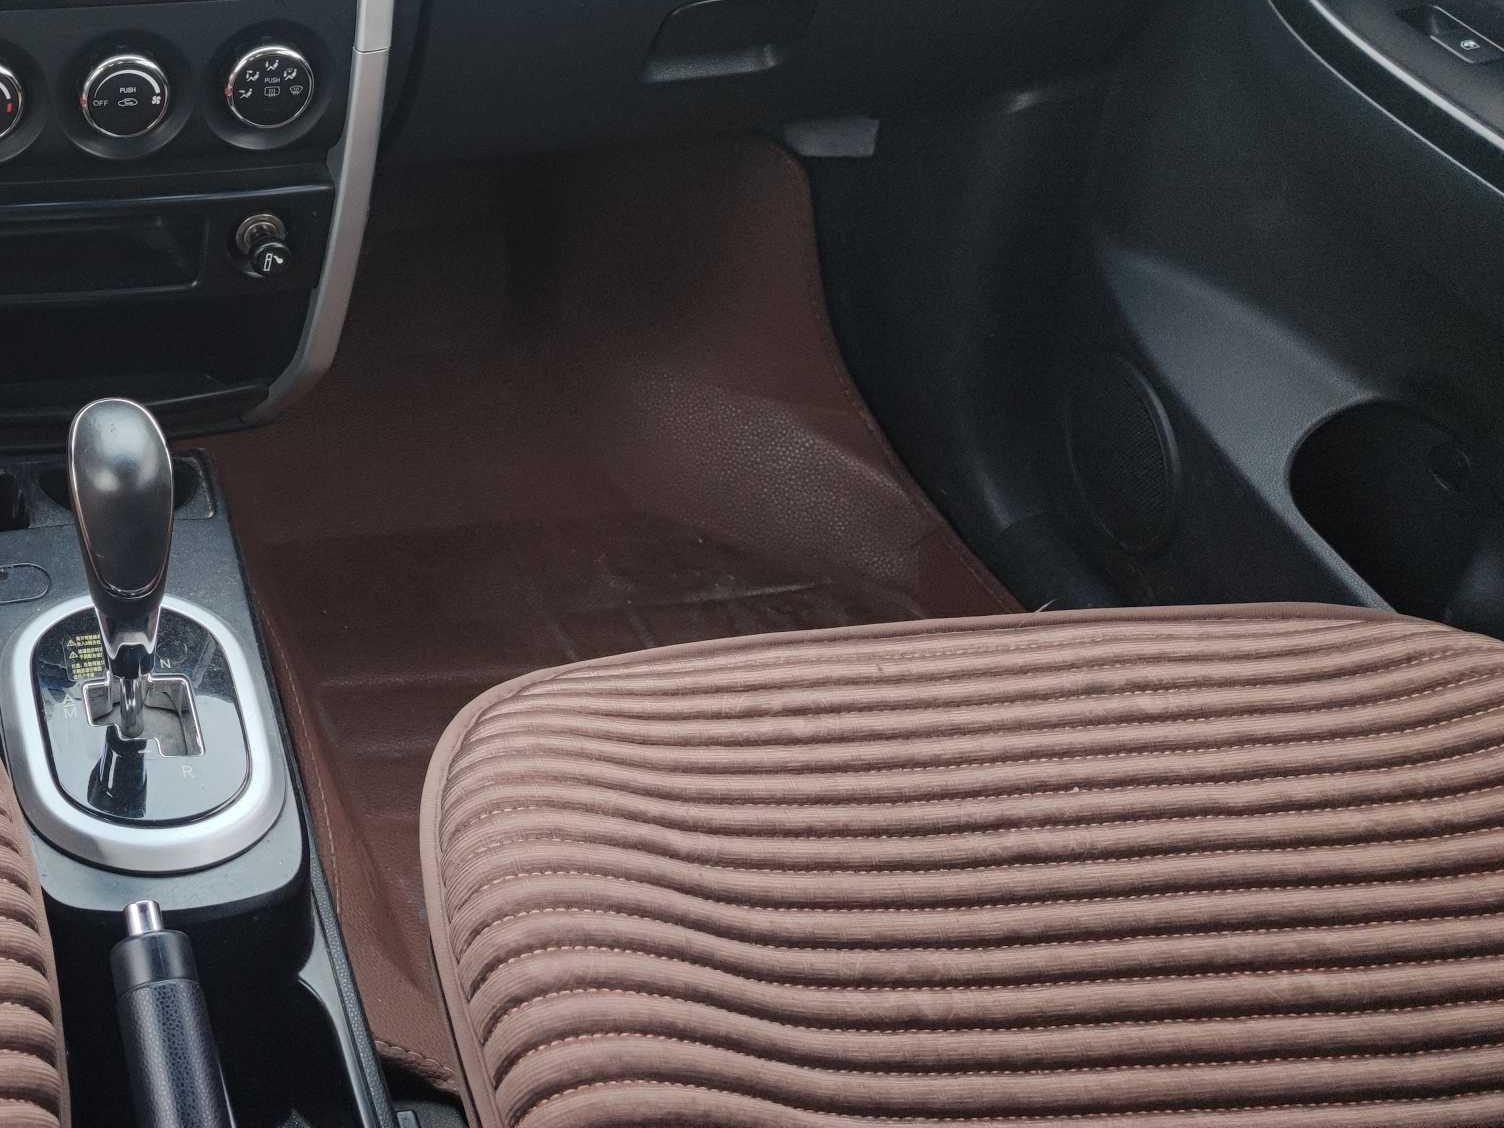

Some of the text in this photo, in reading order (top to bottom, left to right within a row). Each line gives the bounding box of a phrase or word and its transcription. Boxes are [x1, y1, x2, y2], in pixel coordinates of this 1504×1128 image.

[119, 86, 137, 94] PUSH
[92, 99, 109, 107] OFF
[160, 659, 172, 669] N
[63, 694, 74, 705] A
[64, 711, 78, 720] M
[181, 764, 194, 778] R
